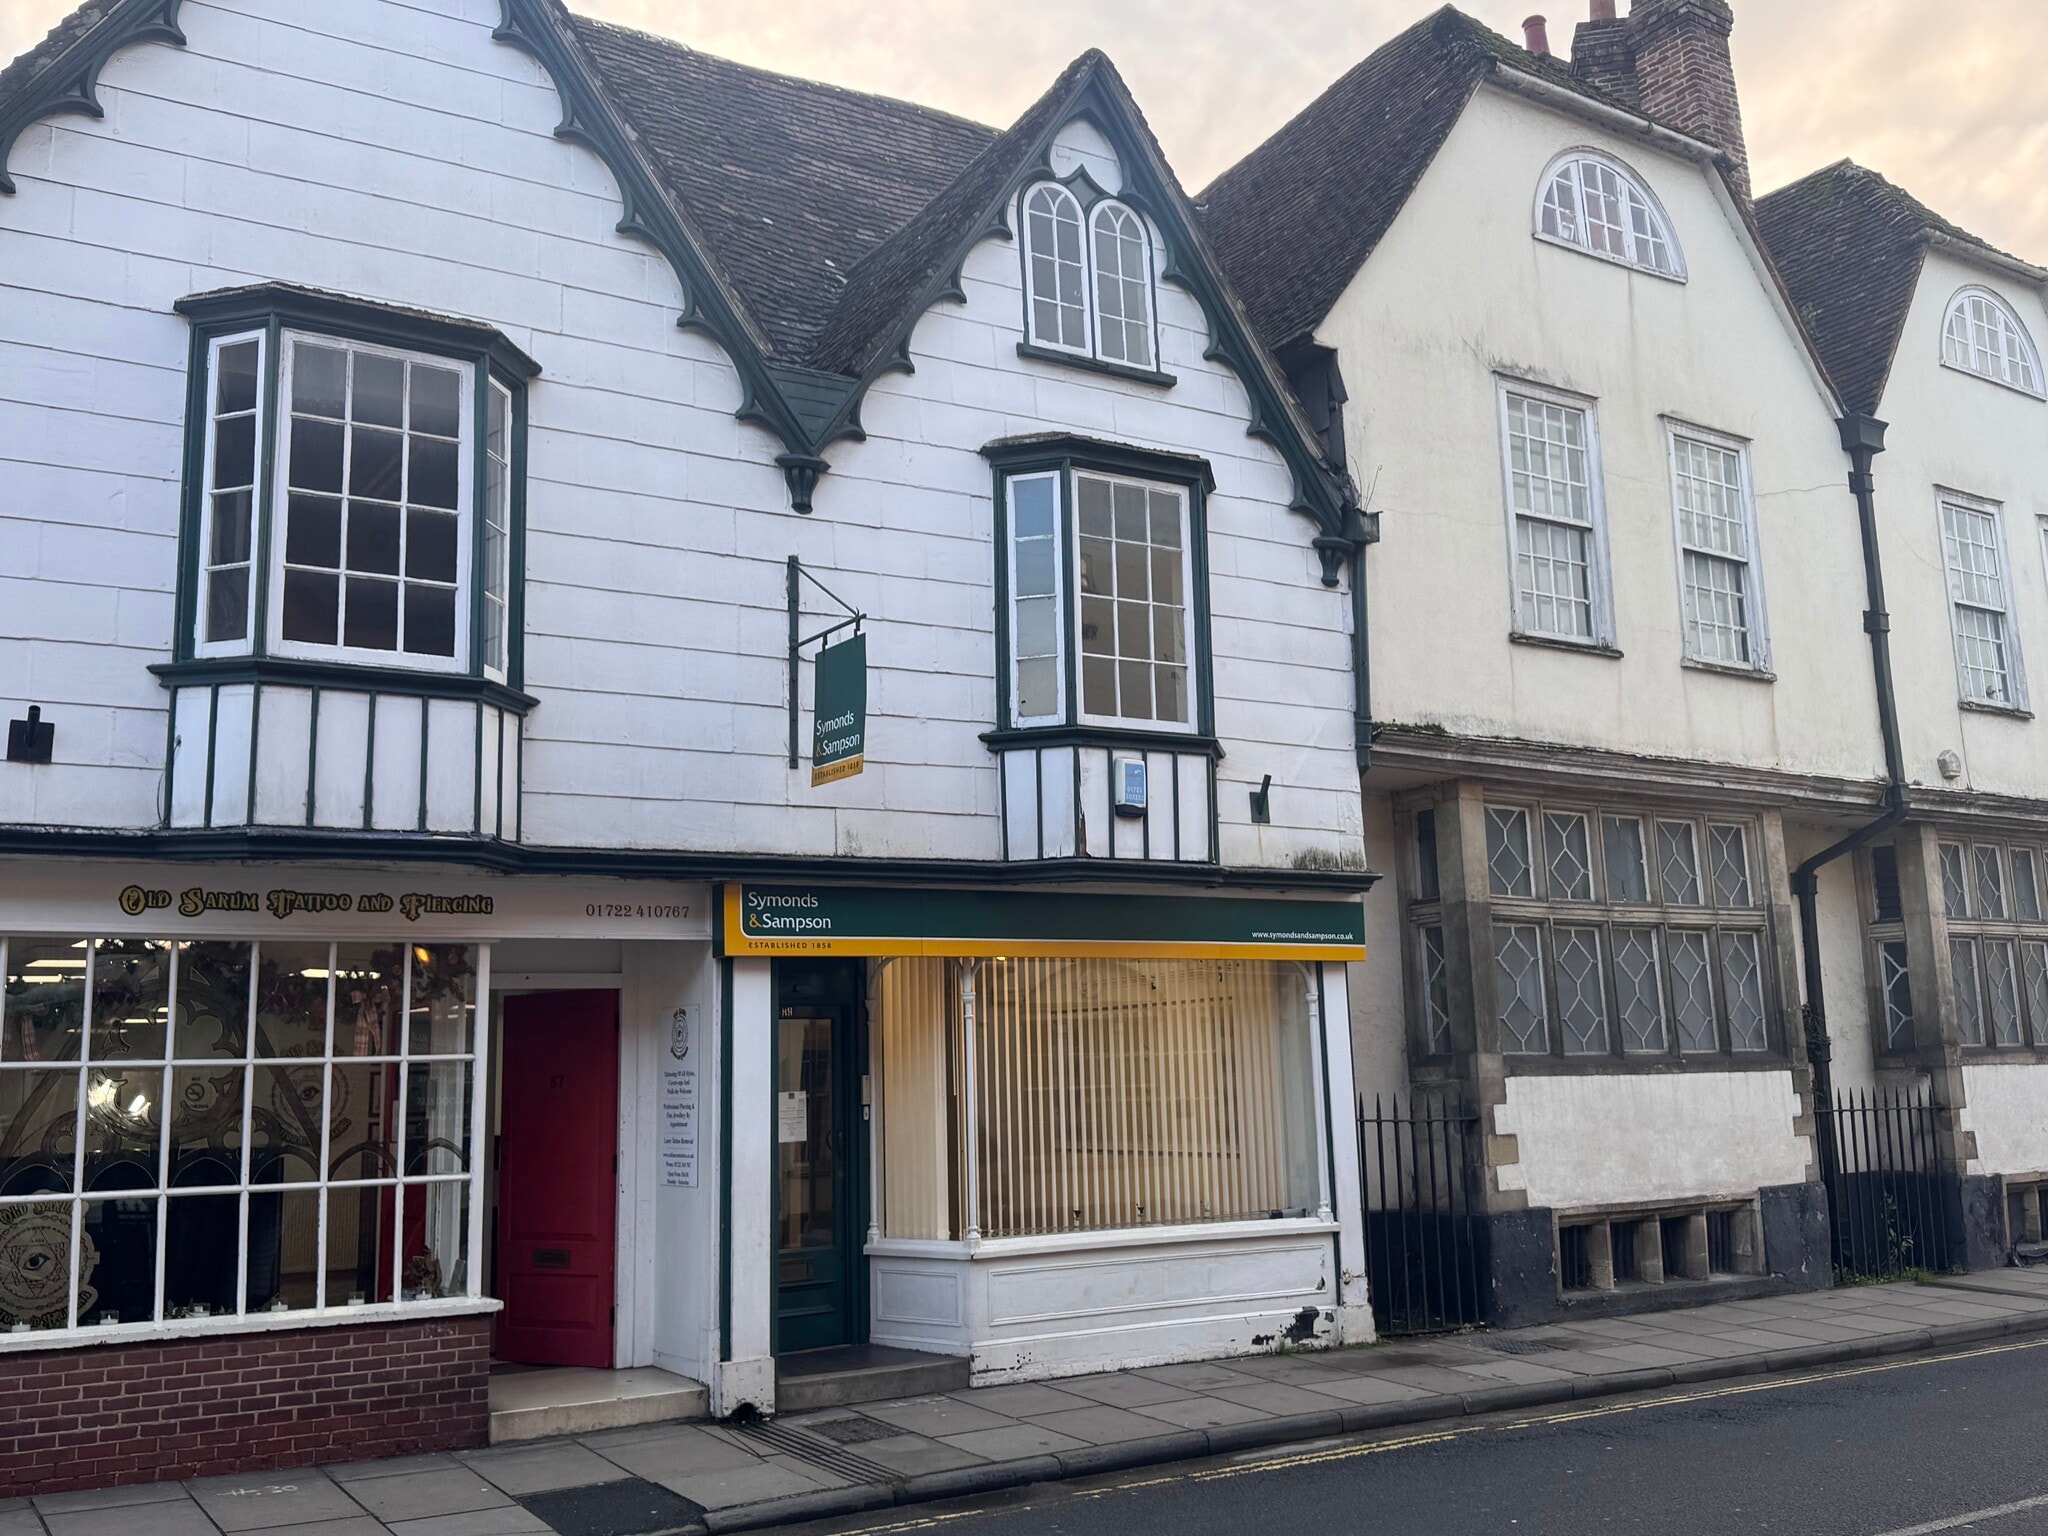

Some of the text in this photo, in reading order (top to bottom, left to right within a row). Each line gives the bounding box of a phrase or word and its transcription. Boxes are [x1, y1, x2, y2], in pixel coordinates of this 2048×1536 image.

[816, 710, 854, 738] Symonds
[748, 891, 819, 910] Symonds
[585, 903, 690, 919] 01722 410767
[1251, 931, 1354, 941] www.symondsandsampson.co.uk
[748, 941, 832, 949] ESTABLISHED 1858
